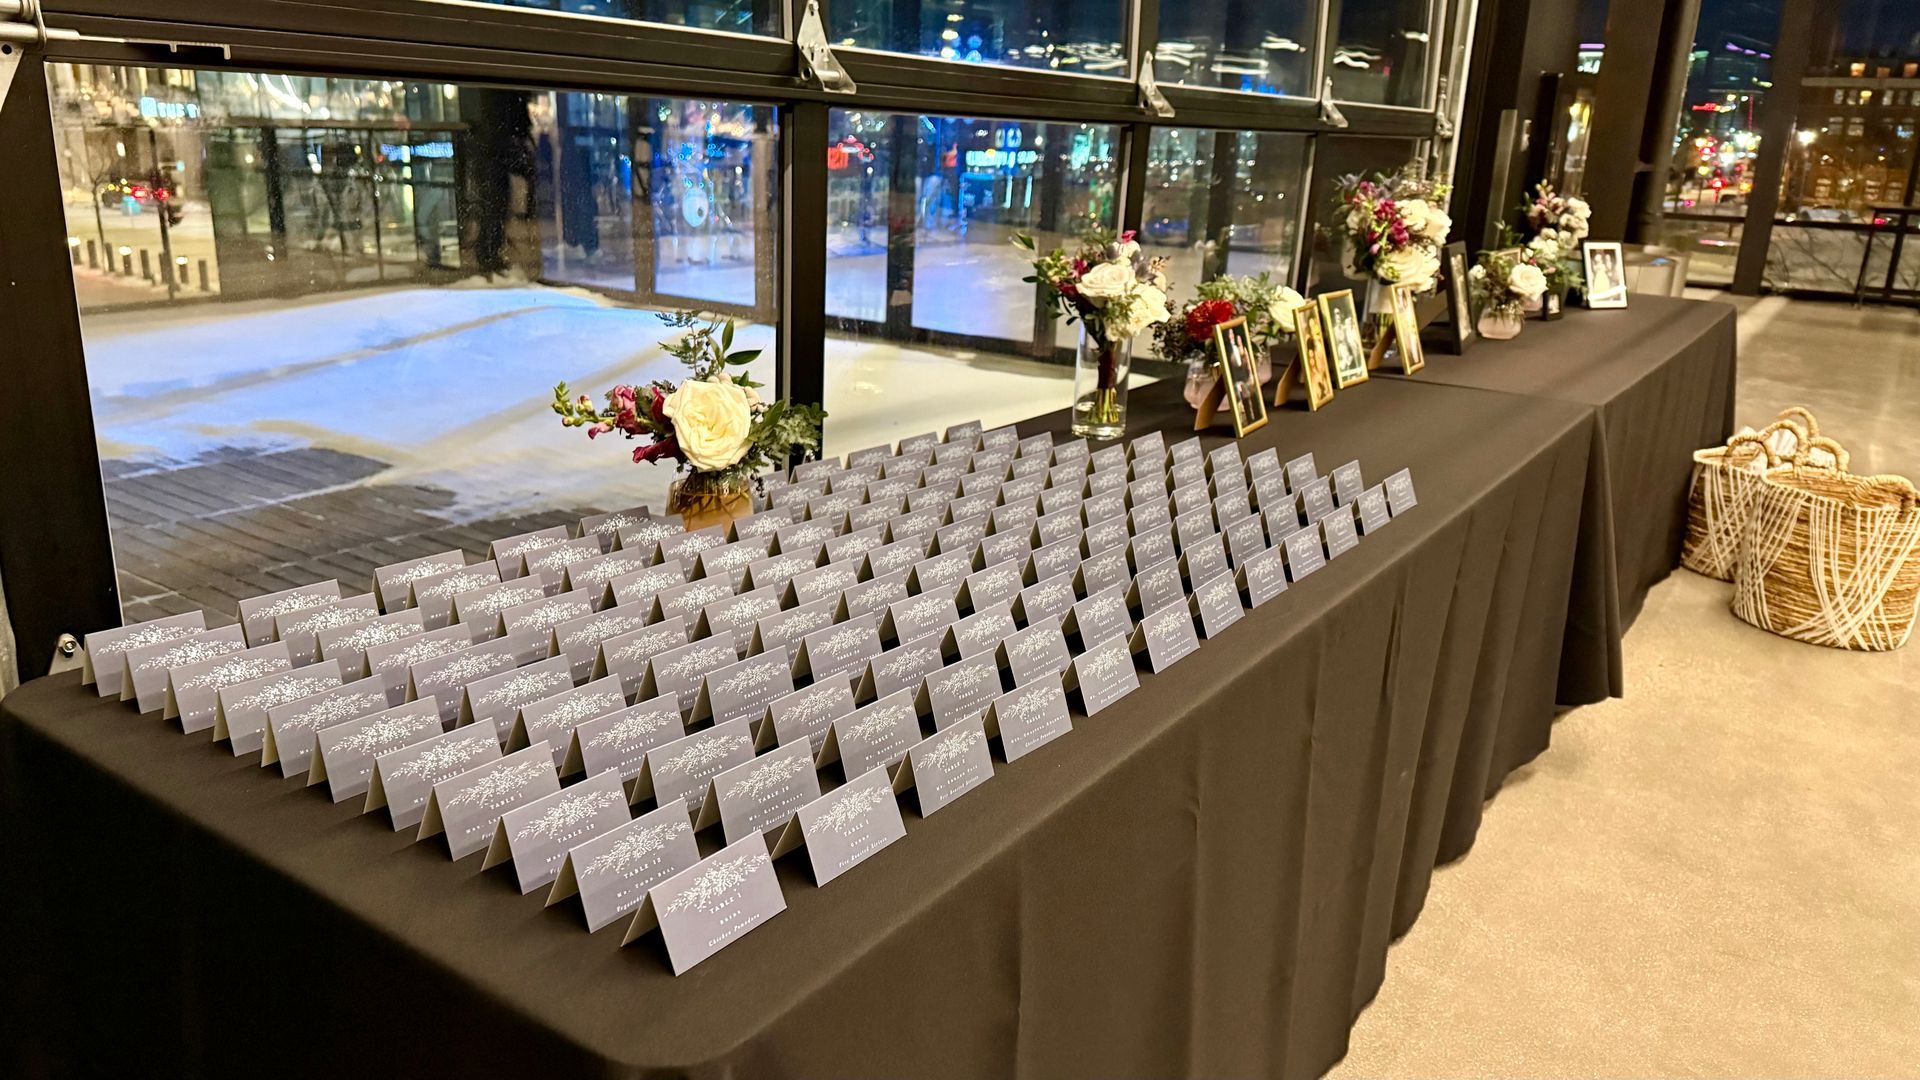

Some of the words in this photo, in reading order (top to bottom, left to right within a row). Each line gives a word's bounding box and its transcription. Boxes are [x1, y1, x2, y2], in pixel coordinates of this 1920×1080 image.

[744, 689, 761, 699] TABLE
[808, 716, 826, 727] TABLE
[871, 734, 888, 746] TABLE
[621, 742, 643, 754] TABLE
[693, 767, 715, 779] TABLE
[944, 761, 960, 774] TABLE
[432, 771, 459, 783] TABLE
[490, 796, 515, 810] TABLE
[758, 790, 779, 804] TABLE
[557, 829, 582, 843] TABLE
[843, 823, 863, 837] TABLE
[623, 863, 649, 879] TABLE
[709, 896, 734, 914] TABLE
